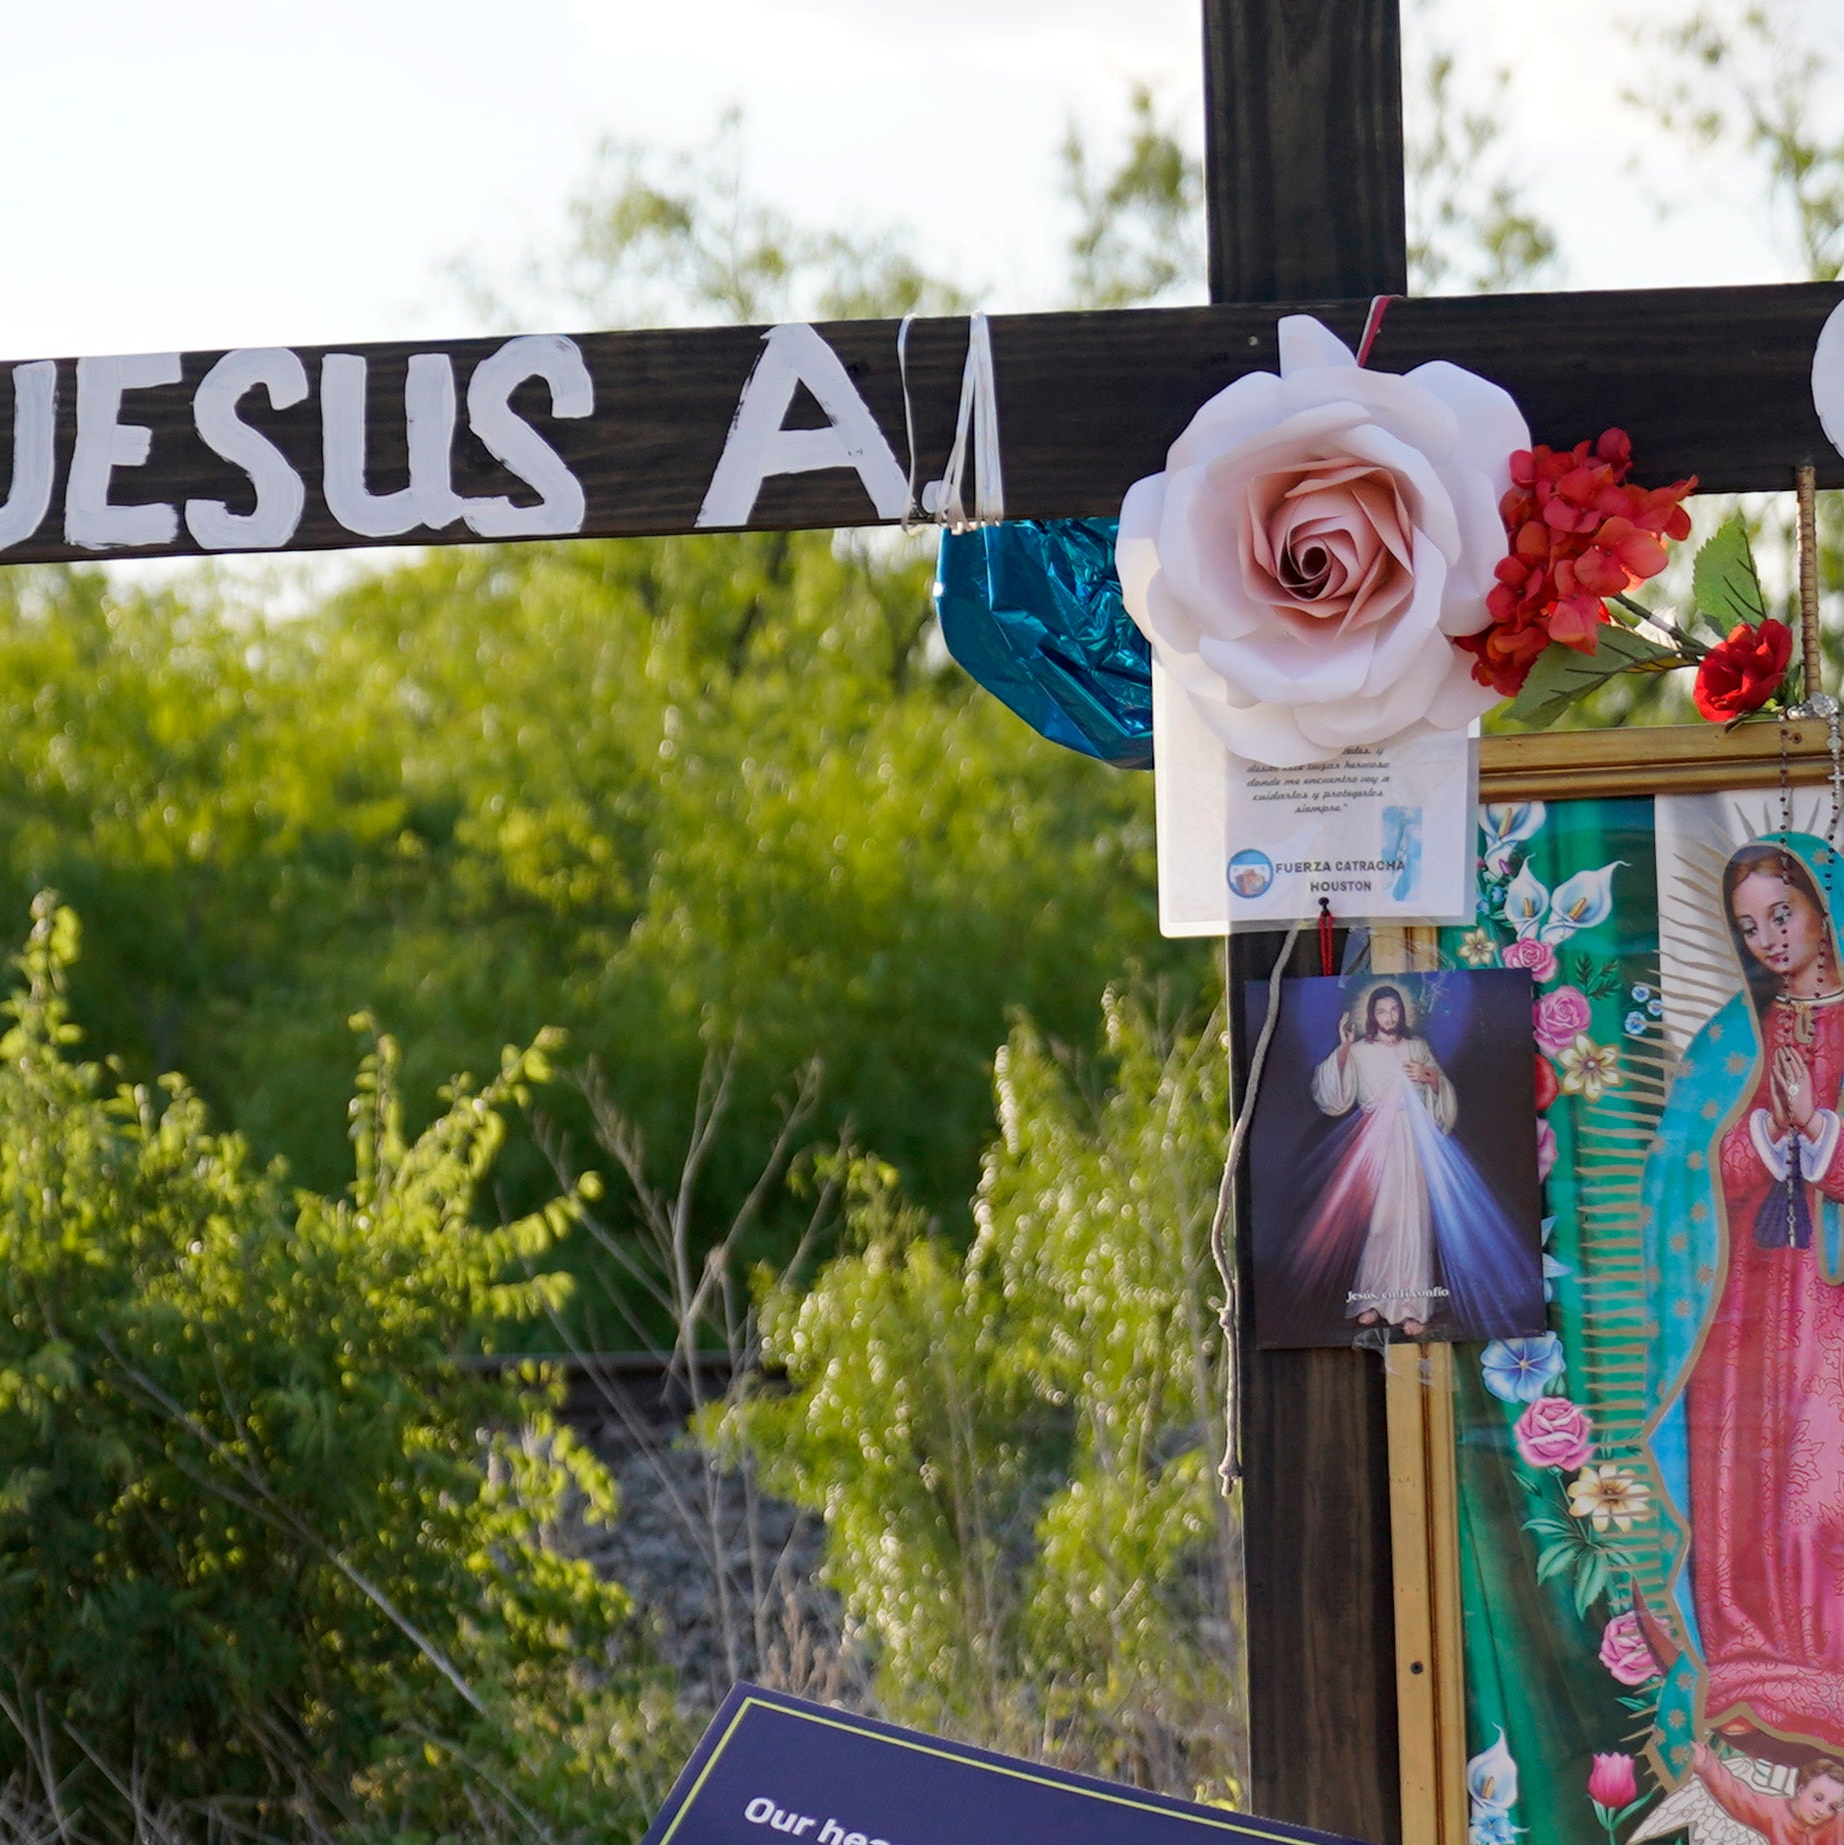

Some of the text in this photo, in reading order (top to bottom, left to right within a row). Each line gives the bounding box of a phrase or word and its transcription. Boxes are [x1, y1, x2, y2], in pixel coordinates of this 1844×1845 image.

[1275, 859, 1405, 874] FUERZA CATRACHA
[1310, 880, 1372, 893] HOUSTON
[744, 1797, 816, 1836] Our
